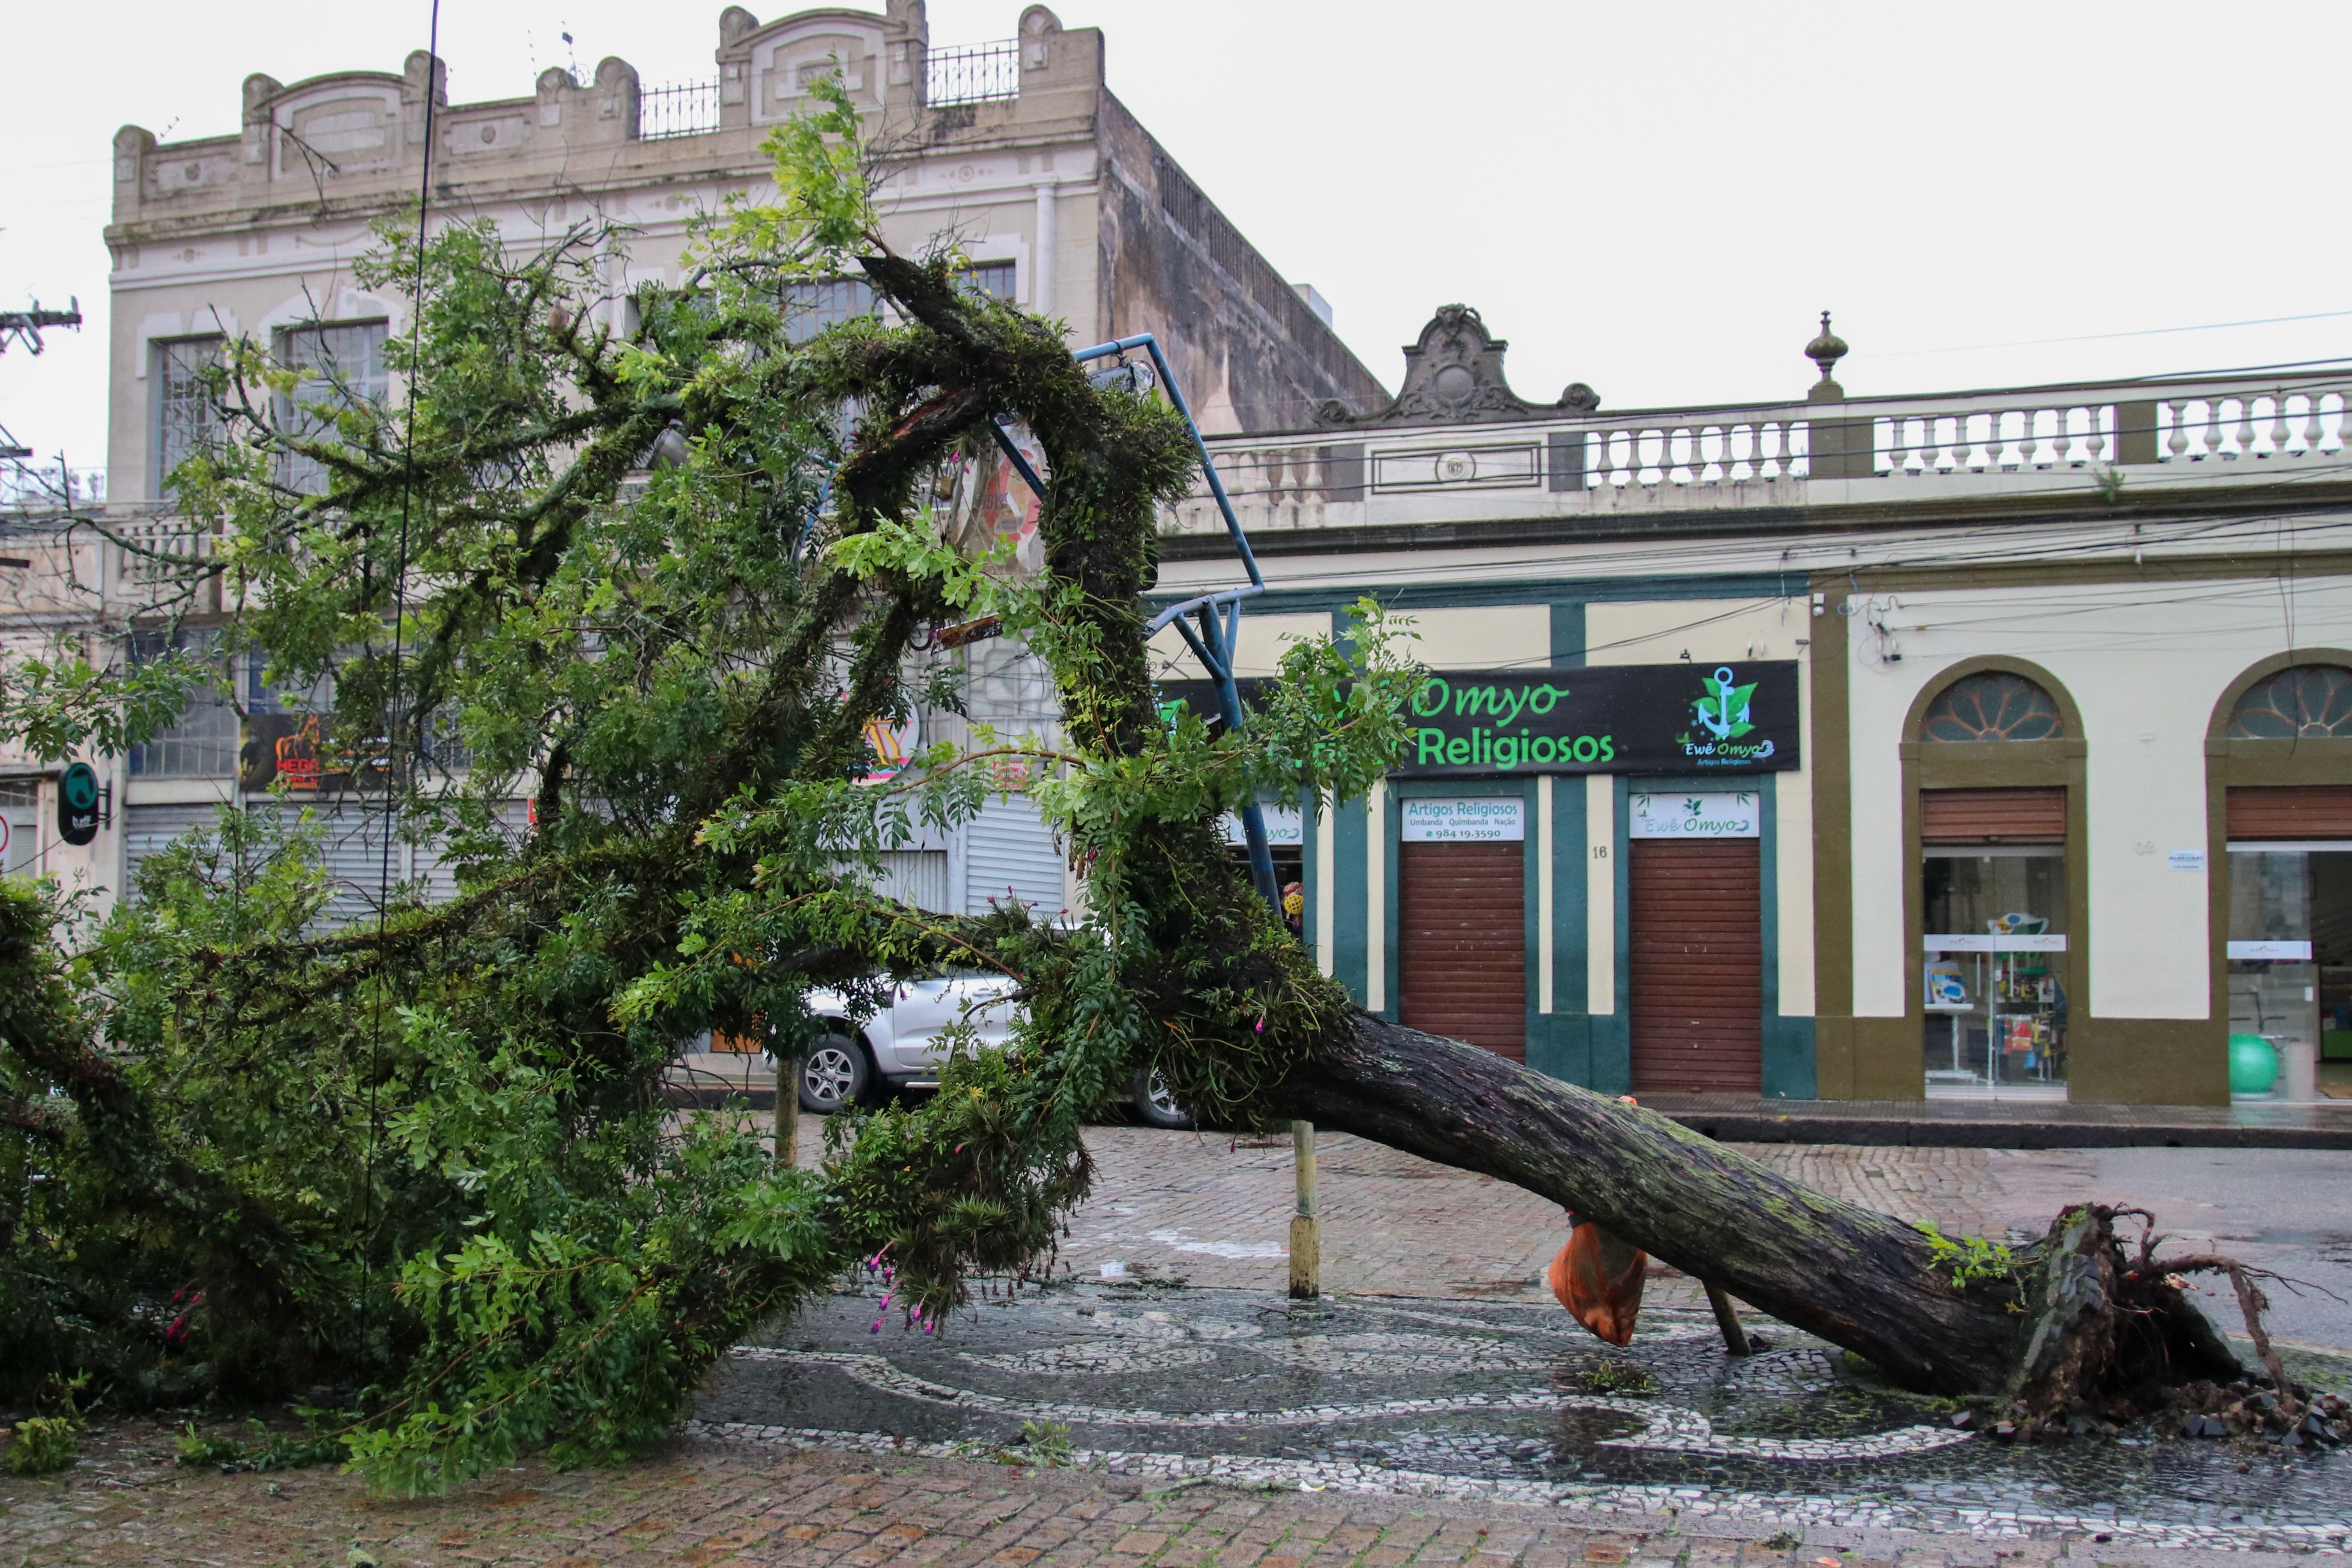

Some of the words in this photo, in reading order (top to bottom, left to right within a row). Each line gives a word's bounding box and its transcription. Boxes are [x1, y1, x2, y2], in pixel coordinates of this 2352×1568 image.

[1411, 678, 1569, 727] Omyo
[1418, 727, 1615, 770] Religiosos
[1686, 743, 1716, 755] Ewê
[1717, 743, 1760, 758] Omyo
[1408, 802, 1453, 817] Artigos
[1457, 801, 1518, 817] Religiosos
[1449, 818, 1489, 827] Quimbanda
[1494, 818, 1516, 827] Nação
[1645, 818, 1682, 832] Ewê
[1684, 818, 1738, 835] Omyo
[1436, 829, 1456, 838] 984
[1593, 846, 1608, 859] 16
